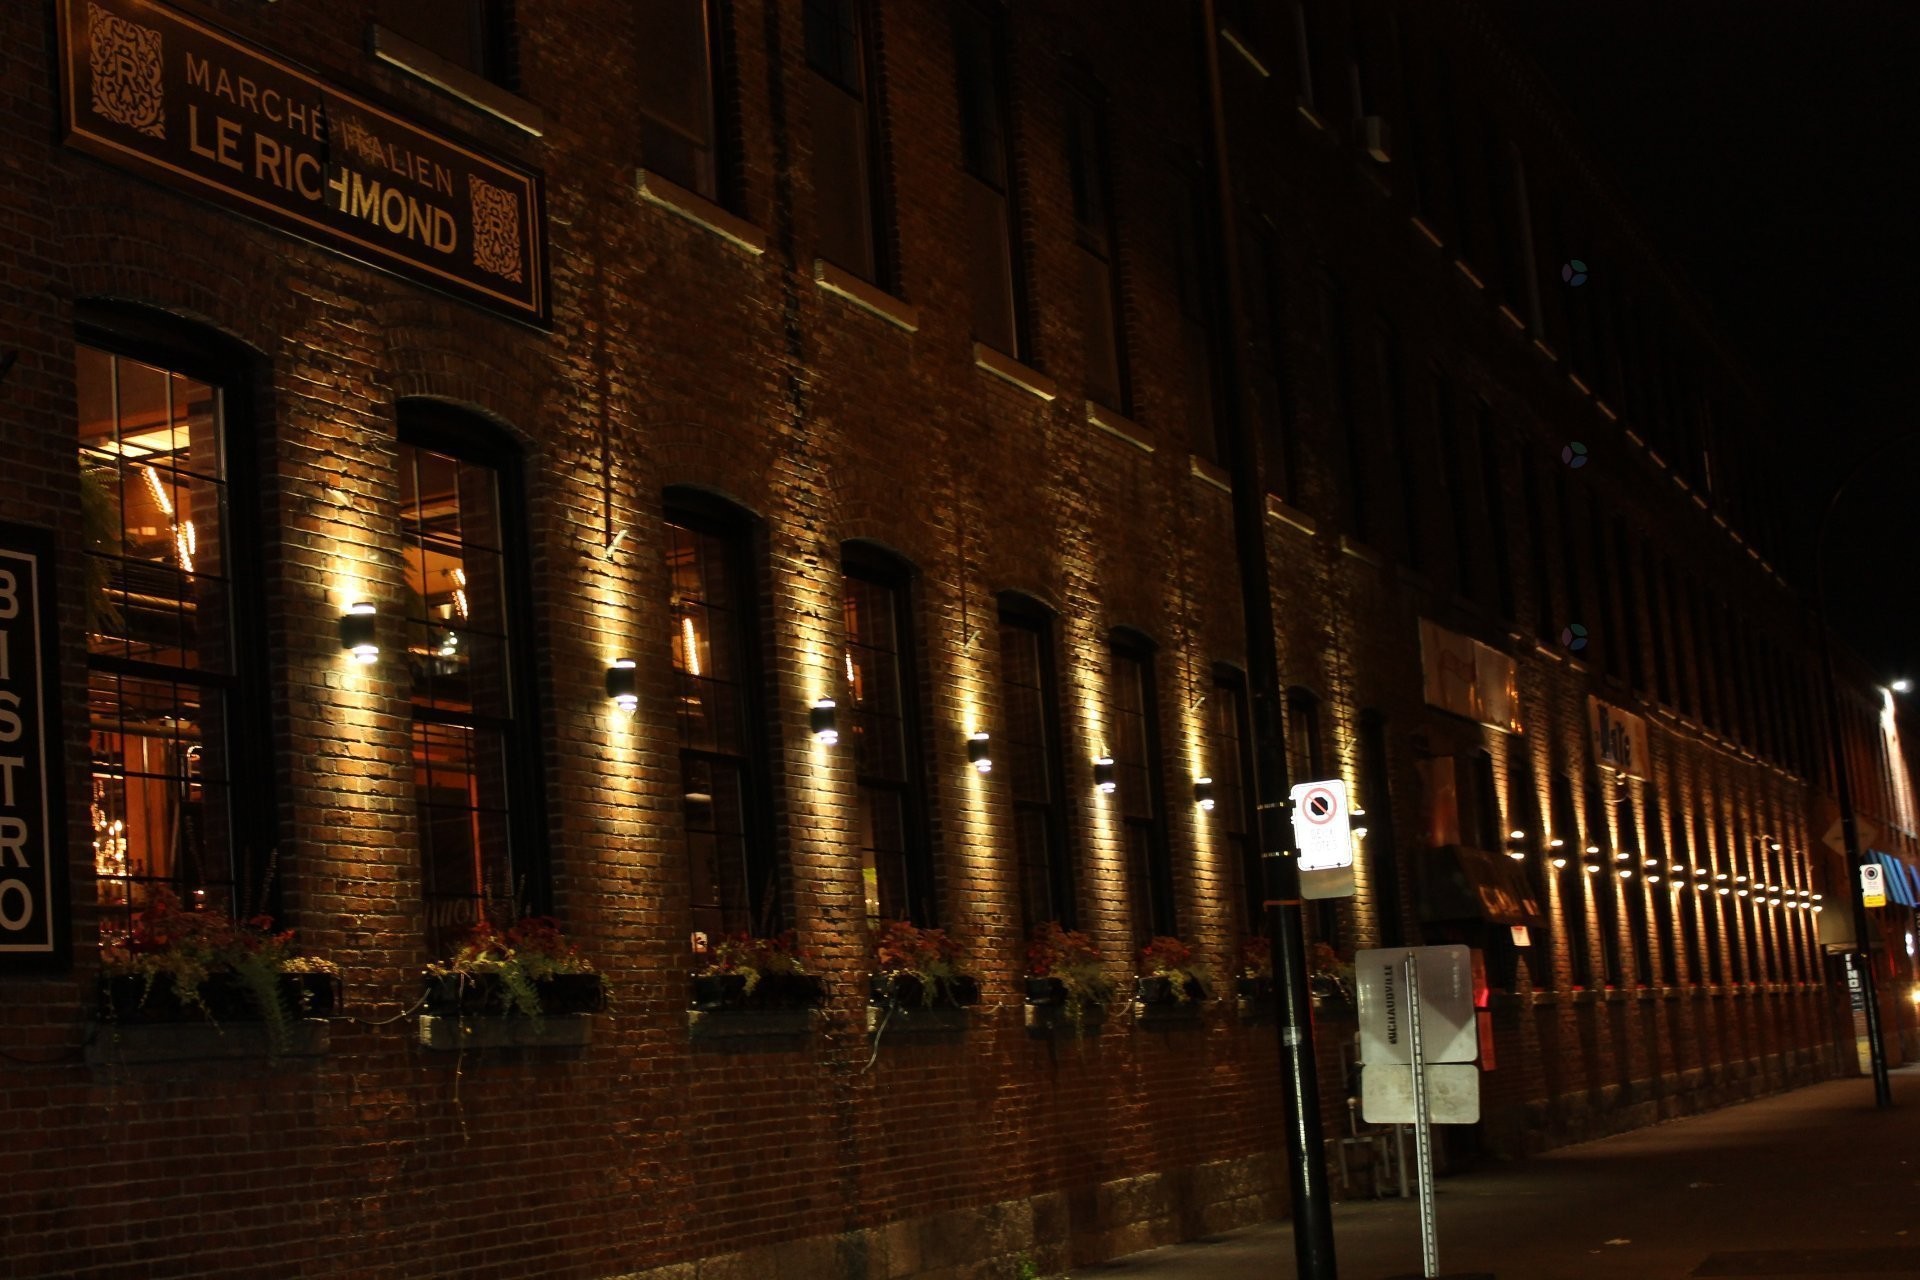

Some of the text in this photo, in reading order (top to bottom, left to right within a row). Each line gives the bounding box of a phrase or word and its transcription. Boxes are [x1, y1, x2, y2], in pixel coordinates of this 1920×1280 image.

[185, 51, 329, 144] MARCHÉ
[188, 104, 459, 255] LE RICHMOND
[0, 568, 34, 932] BISTRO
